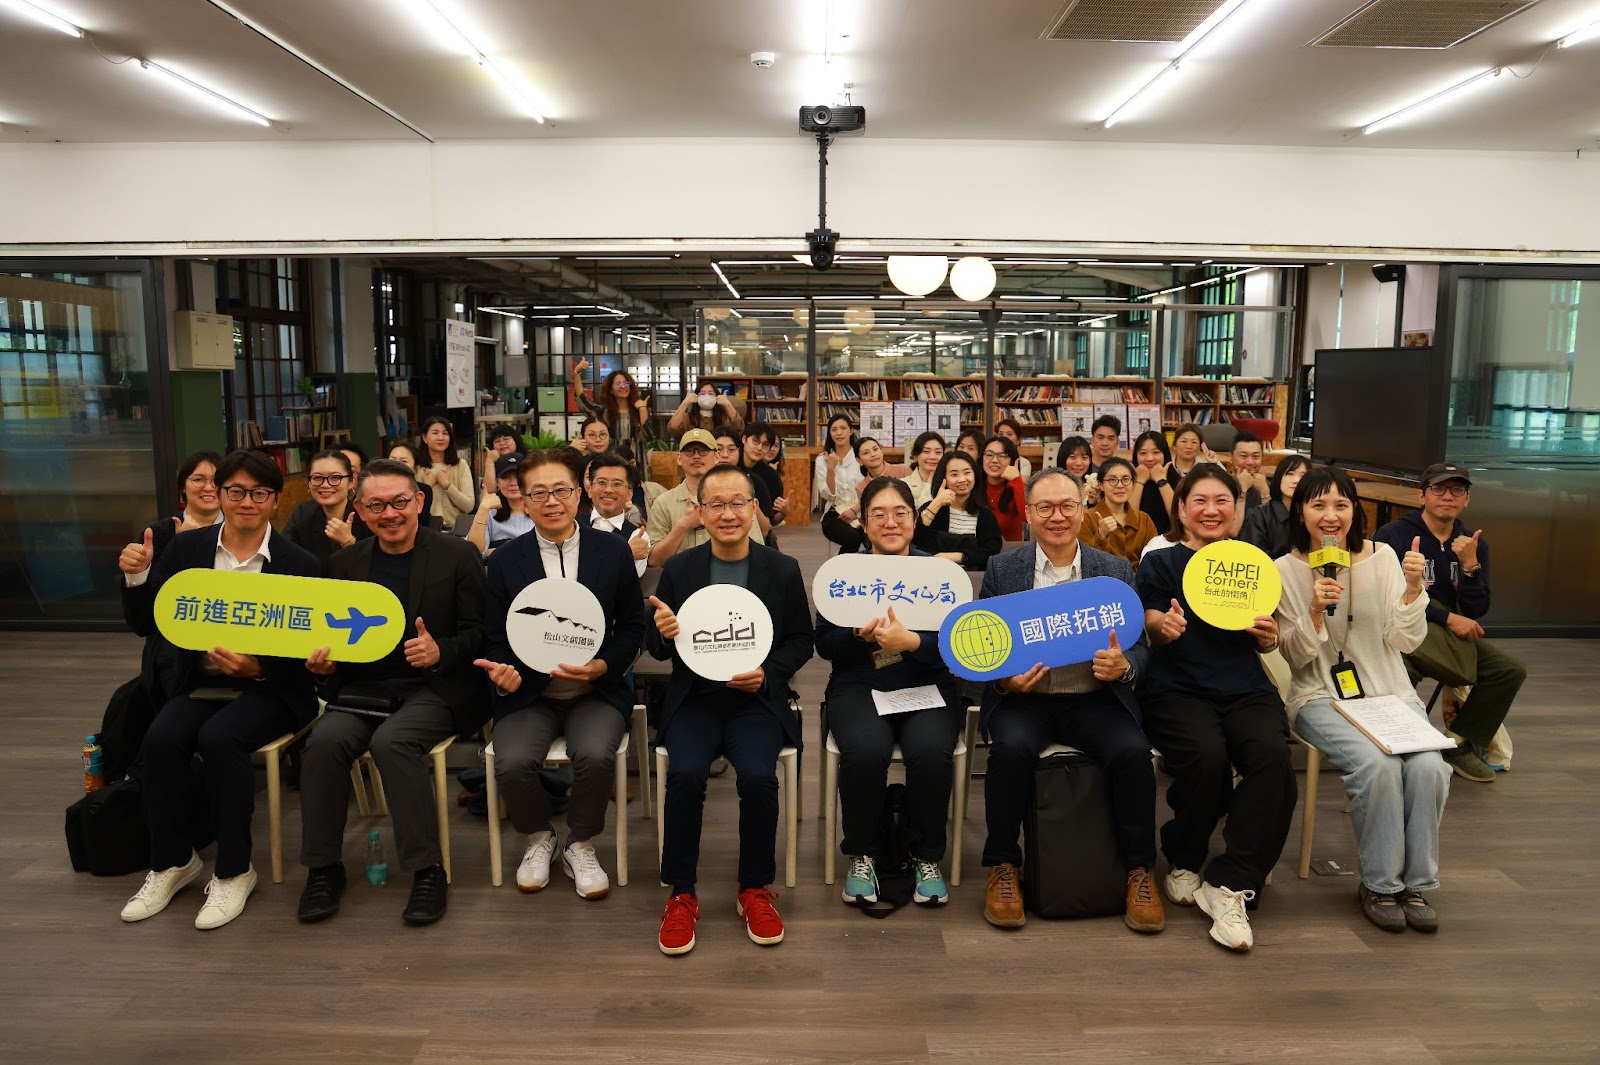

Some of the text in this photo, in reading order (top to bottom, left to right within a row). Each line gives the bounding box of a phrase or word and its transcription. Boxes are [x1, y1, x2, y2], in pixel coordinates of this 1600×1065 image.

[1205, 575, 1258, 590] corners
[1206, 558, 1260, 580] TAIPEI
[829, 578, 956, 605] 台北市文化局
[173, 595, 313, 631] 前進亞洲區
[1019, 602, 1126, 645] 國際拓銷
